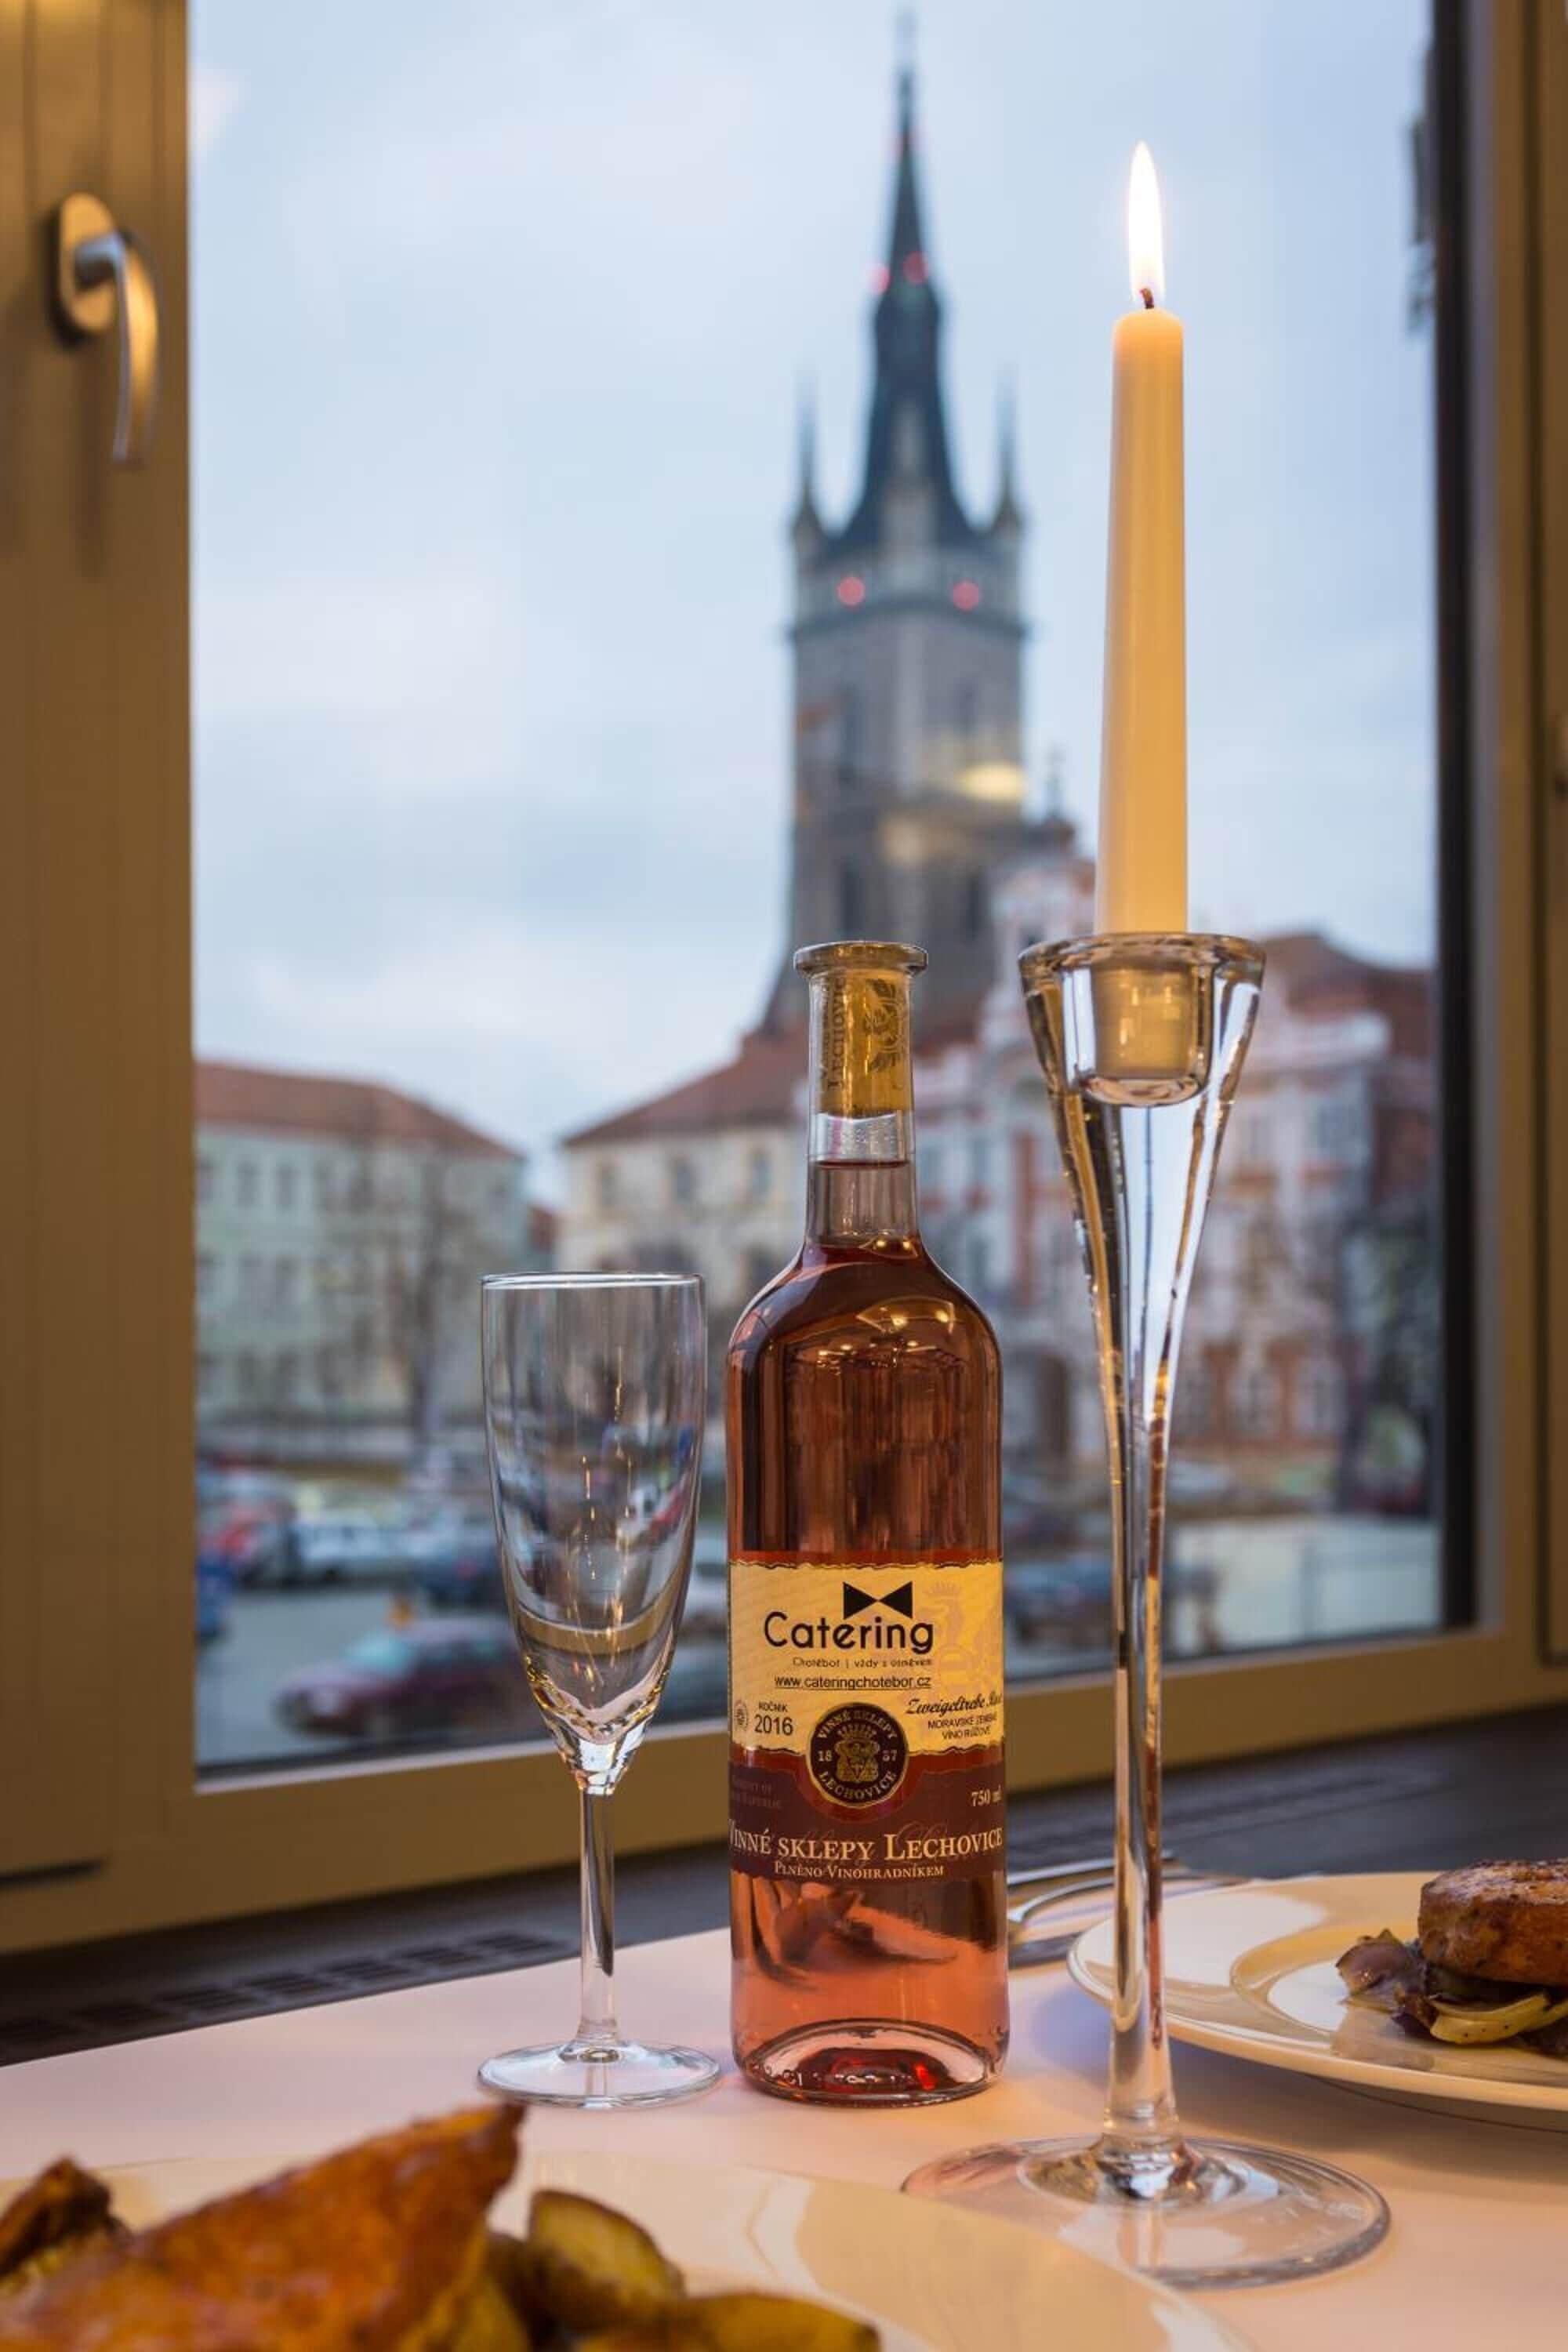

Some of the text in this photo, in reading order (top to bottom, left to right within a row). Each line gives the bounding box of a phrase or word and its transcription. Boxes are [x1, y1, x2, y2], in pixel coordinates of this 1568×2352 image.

[827, 978, 846, 1091] LECHOVIC
[764, 1611, 933, 1654] Catering
[775, 1675, 931, 1690] www.cateringchotebor.cz
[754, 1714, 793, 1736] 2016
[818, 1750, 833, 1762] 18
[818, 1770, 897, 1799] LECHOVICE
[971, 1791, 991, 1806] 750
[778, 1838, 875, 1860] SKLEPY
